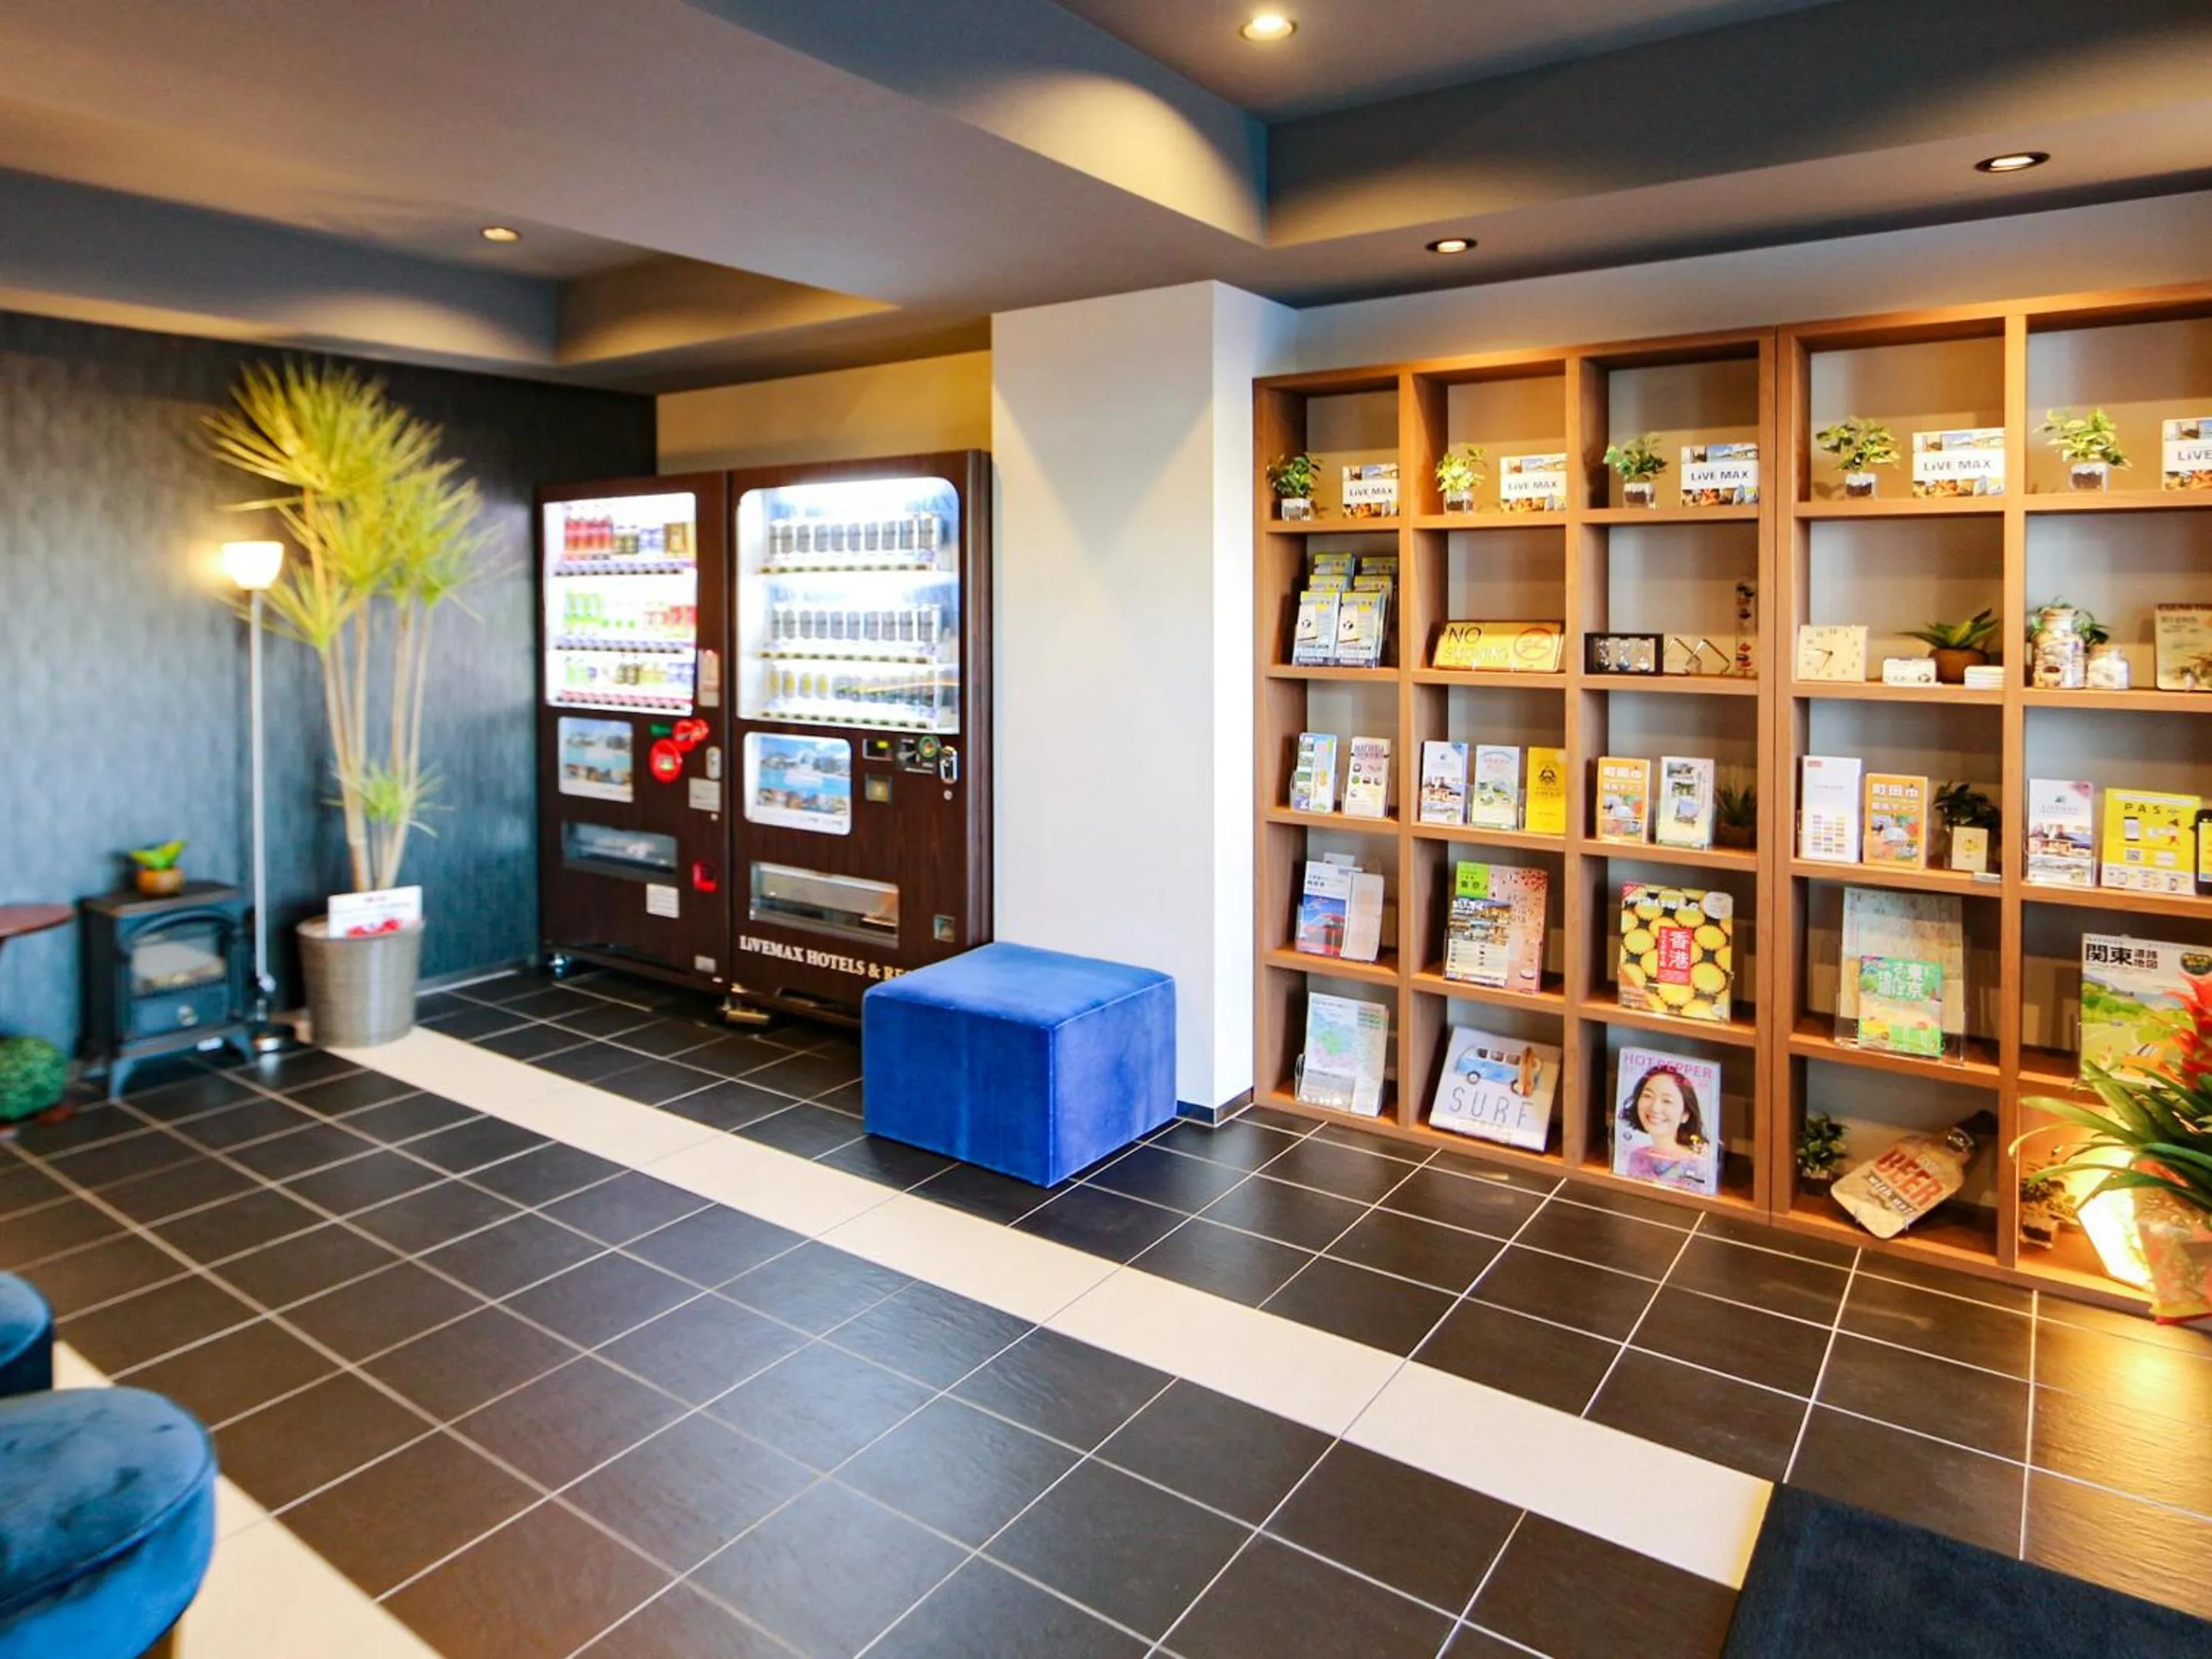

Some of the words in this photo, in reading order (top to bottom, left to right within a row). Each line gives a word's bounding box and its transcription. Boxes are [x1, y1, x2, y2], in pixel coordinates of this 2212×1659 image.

[1720, 469, 1749, 479] MAX
[1958, 459, 1992, 469] MAX
[1371, 486, 1393, 495] MAX
[1532, 479, 1557, 489] MAX
[1447, 626, 1482, 645] NO
[806, 949, 866, 976] HOTELS
[868, 962, 881, 979] &
[2085, 942, 2133, 966] 関東
[1623, 1052, 1654, 1068] HOT
[1656, 1058, 1713, 1079] PEPPER
[1449, 1086, 1535, 1130] SURF
[1874, 1148, 1944, 1209] BEER
